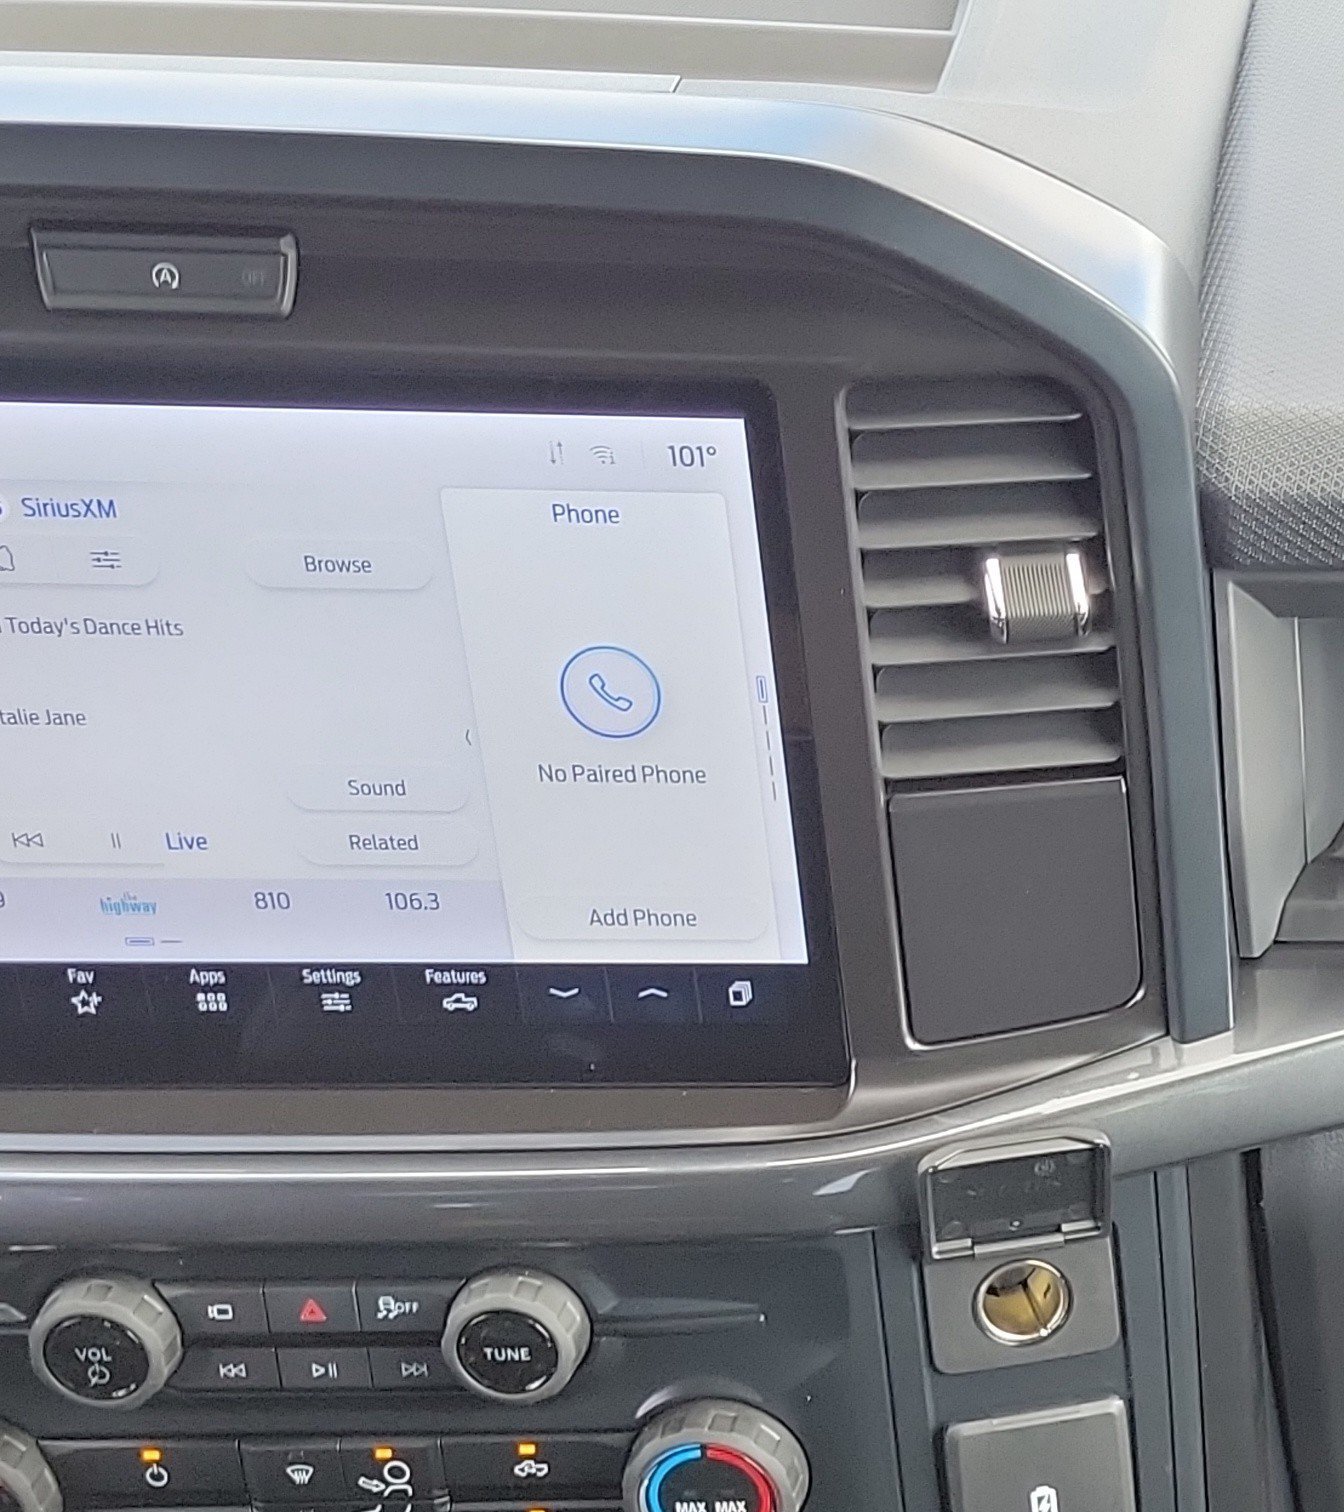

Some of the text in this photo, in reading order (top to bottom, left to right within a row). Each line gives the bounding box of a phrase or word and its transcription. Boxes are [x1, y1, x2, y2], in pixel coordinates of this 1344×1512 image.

[667, 445, 717, 467] 101°
[21, 497, 118, 519] SiriusXM
[552, 503, 620, 524] Phone
[304, 555, 373, 574] Browse
[4, 616, 184, 638] Today's Dance Hits
[45, 709, 87, 726] Jane
[538, 764, 707, 784] No Paired Phone
[347, 779, 407, 798] Sound
[165, 832, 209, 851] Live
[348, 834, 419, 852] Related
[100, 898, 157, 916] highway
[254, 892, 292, 911] 810
[385, 892, 440, 911] 106.3
[589, 908, 698, 928] Add Phone
[67, 969, 94, 985] Fav
[190, 969, 226, 986] Apps
[302, 969, 361, 986] Settings
[425, 969, 486, 985] Features
[396, 1301, 419, 1314] OFF
[75, 1347, 112, 1362] VOL
[483, 1347, 531, 1362] TUNE
